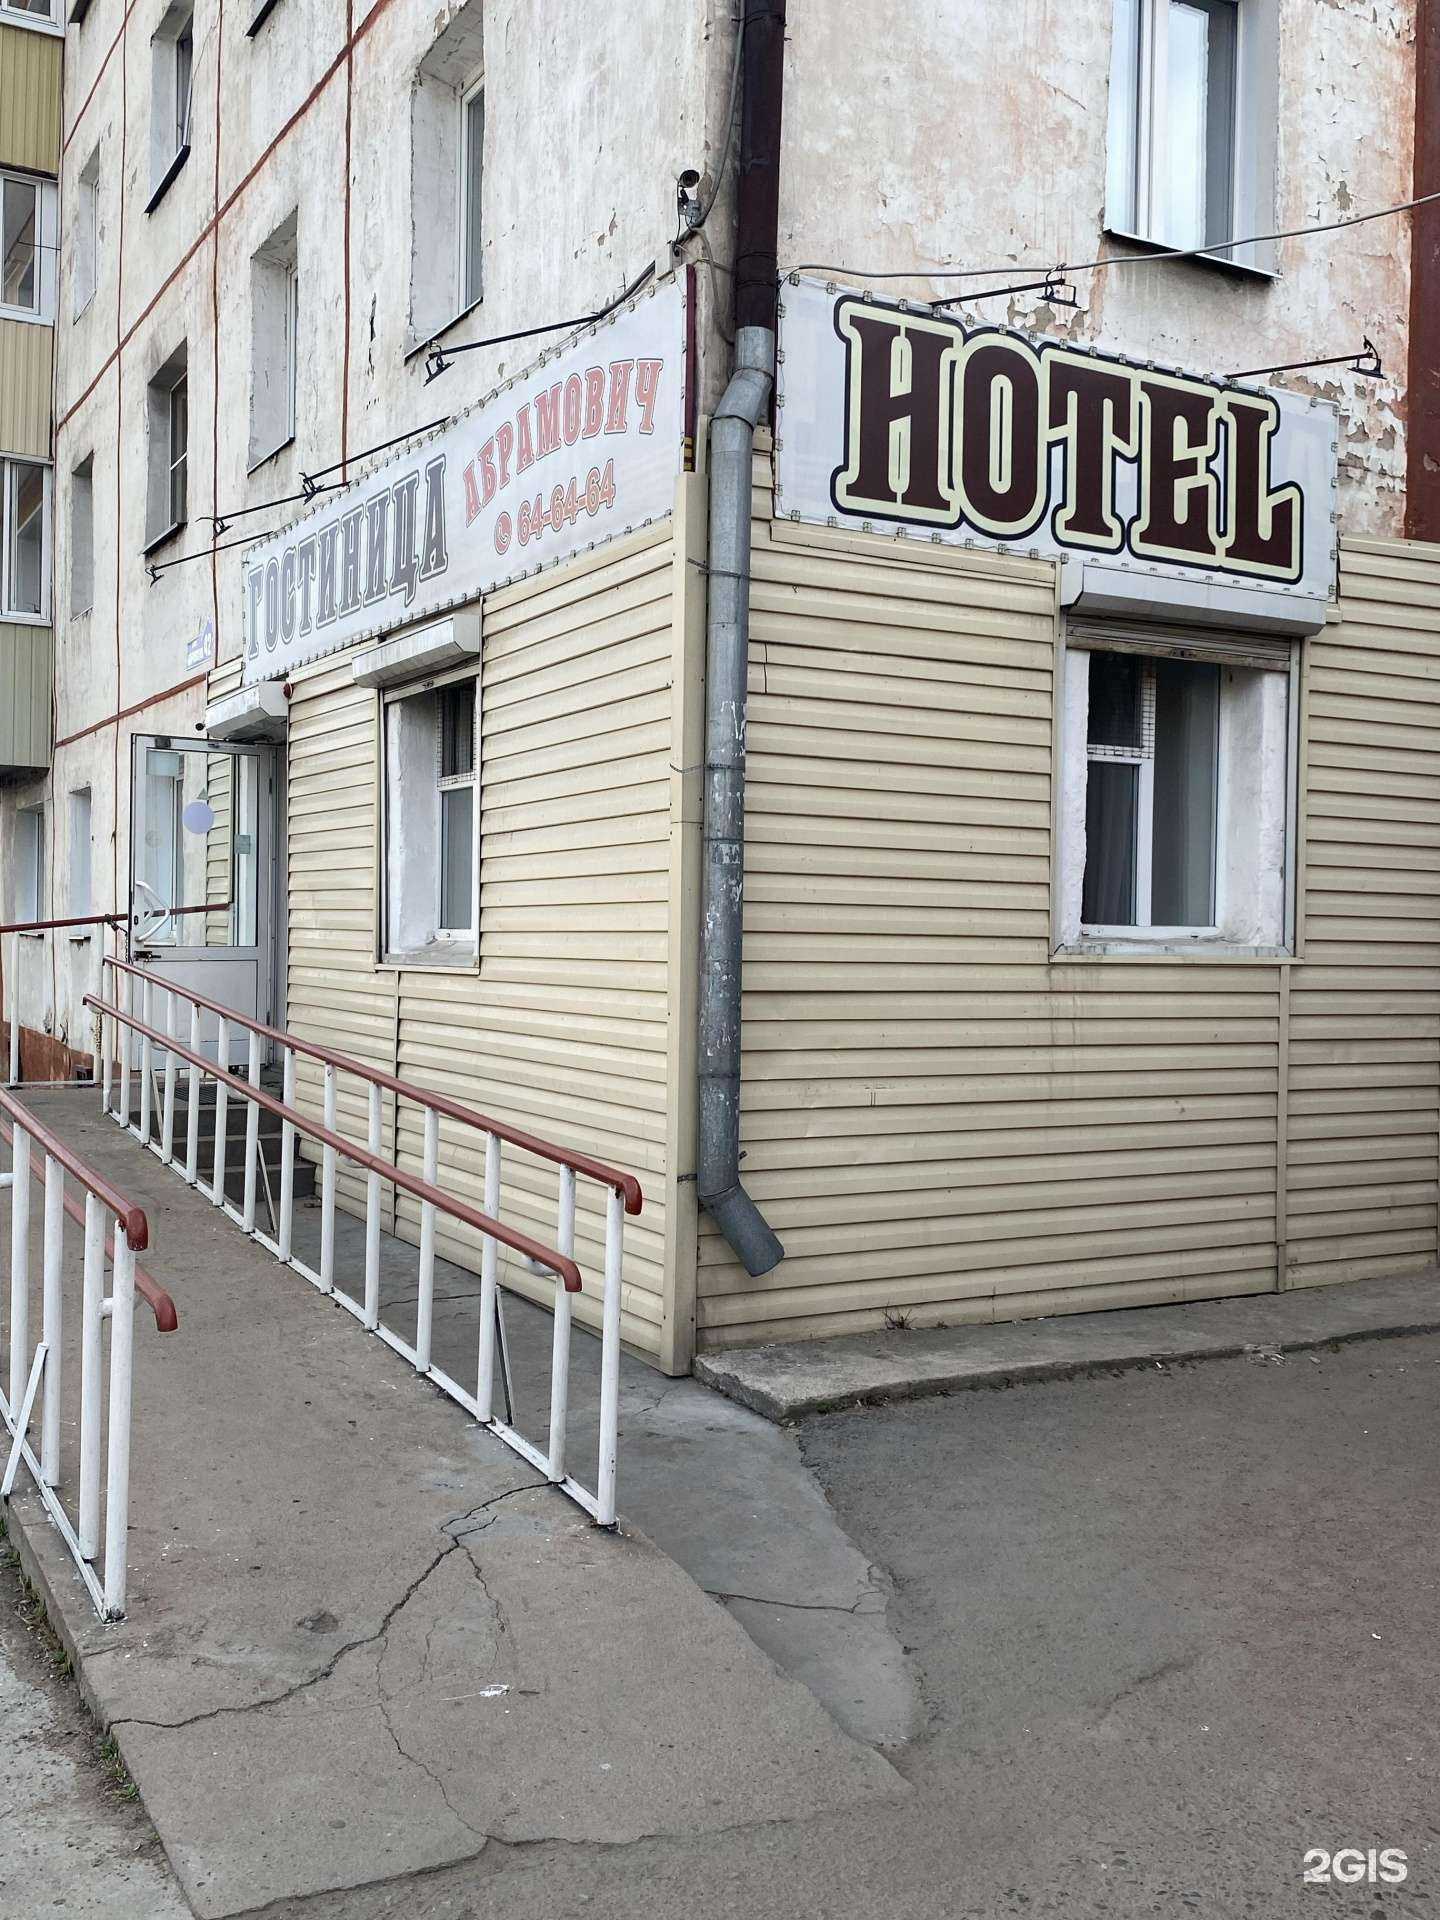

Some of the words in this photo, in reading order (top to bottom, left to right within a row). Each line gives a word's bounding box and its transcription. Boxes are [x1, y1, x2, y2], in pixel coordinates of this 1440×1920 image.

[463, 359, 664, 528] АБРАМОВИЧ
[517, 458, 616, 546] 64-64-64
[830, 295, 1304, 585] HOTEL
[248, 453, 448, 661] ГОСТИНИЦА
